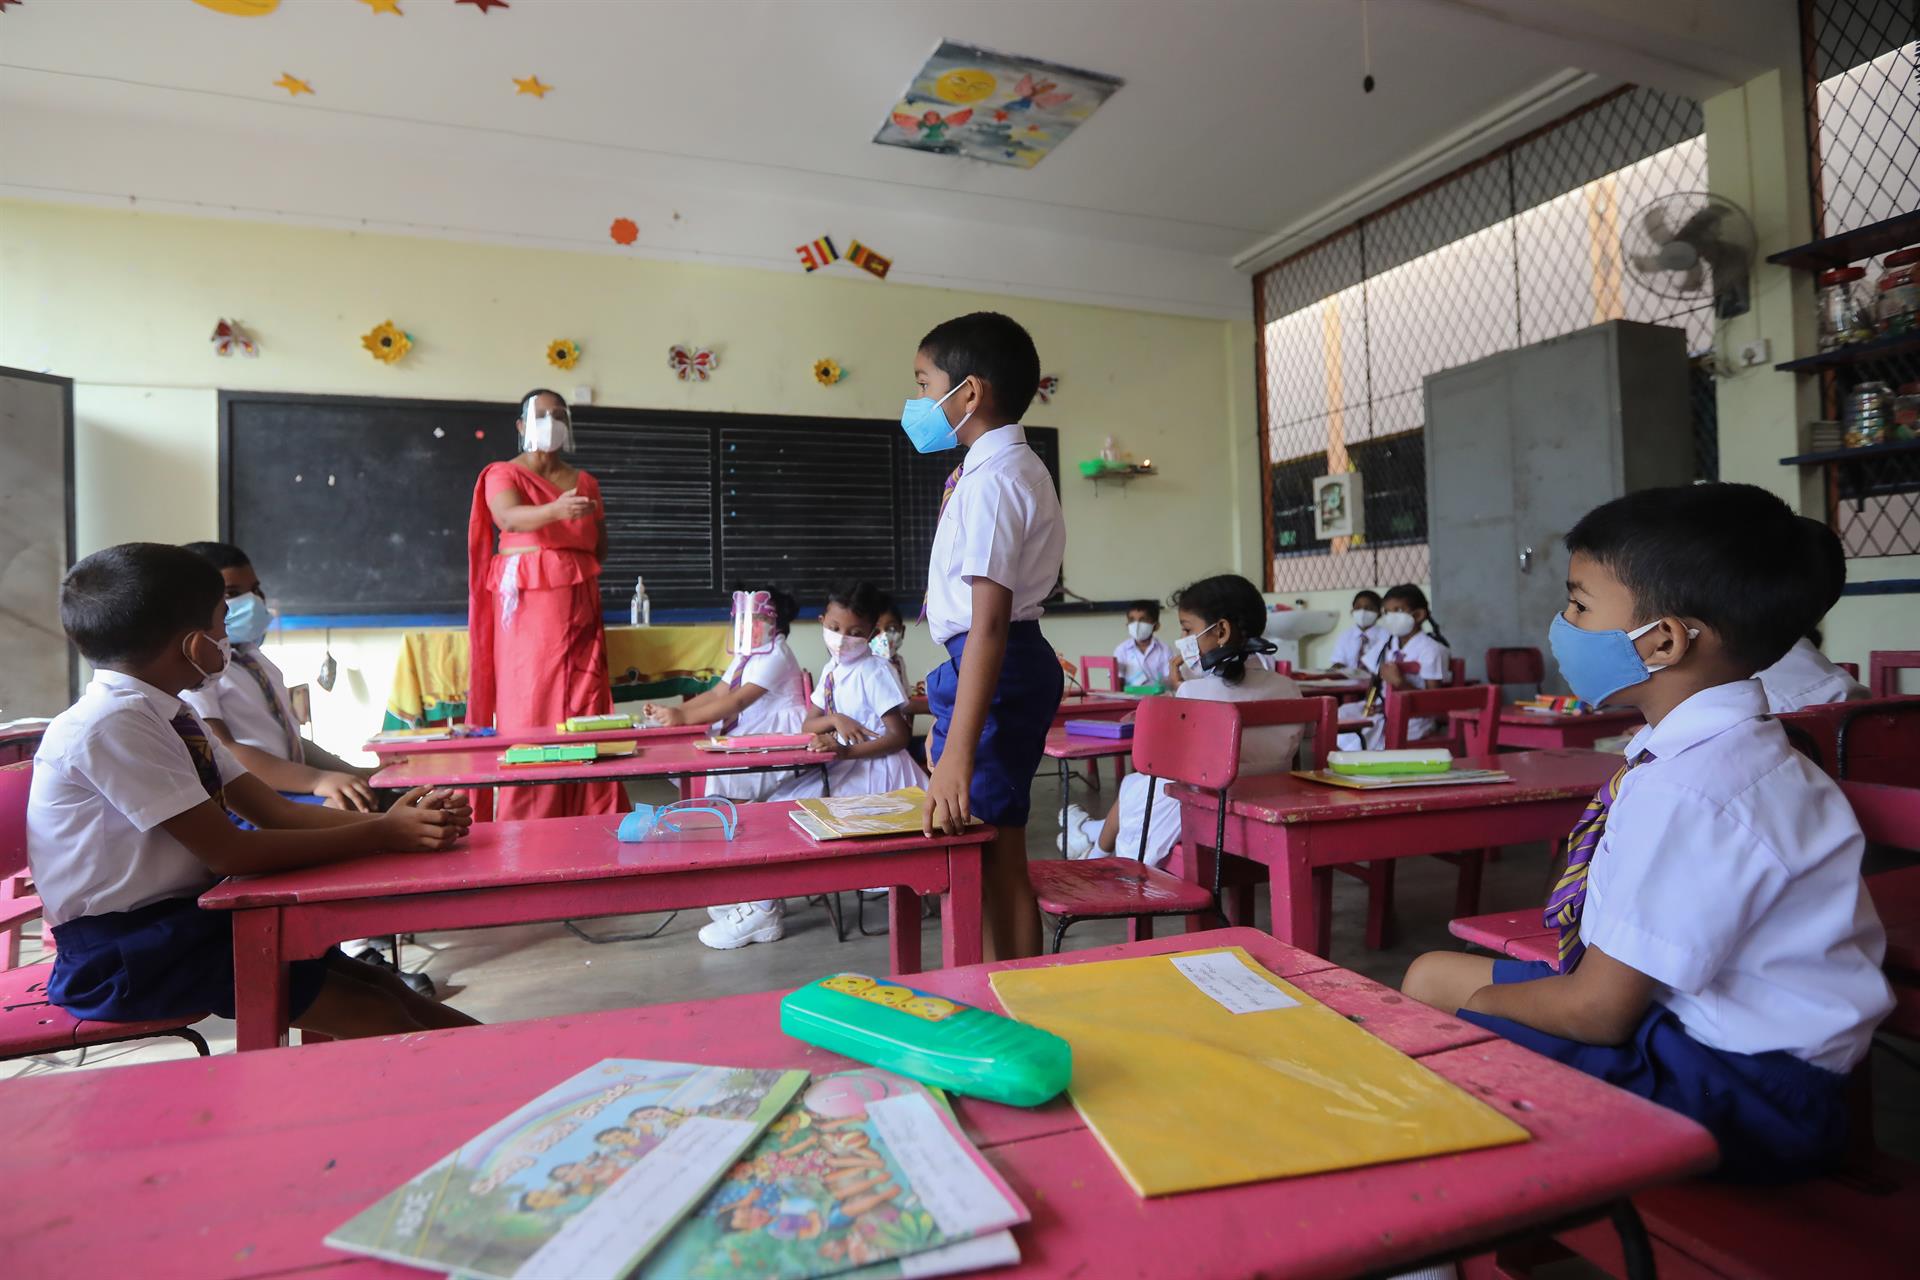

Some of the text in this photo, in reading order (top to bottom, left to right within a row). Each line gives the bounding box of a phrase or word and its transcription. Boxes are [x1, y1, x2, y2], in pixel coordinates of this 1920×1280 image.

[469, 1155, 537, 1195] Song
[531, 1121, 584, 1153] Book
[574, 1083, 633, 1120] Grade
